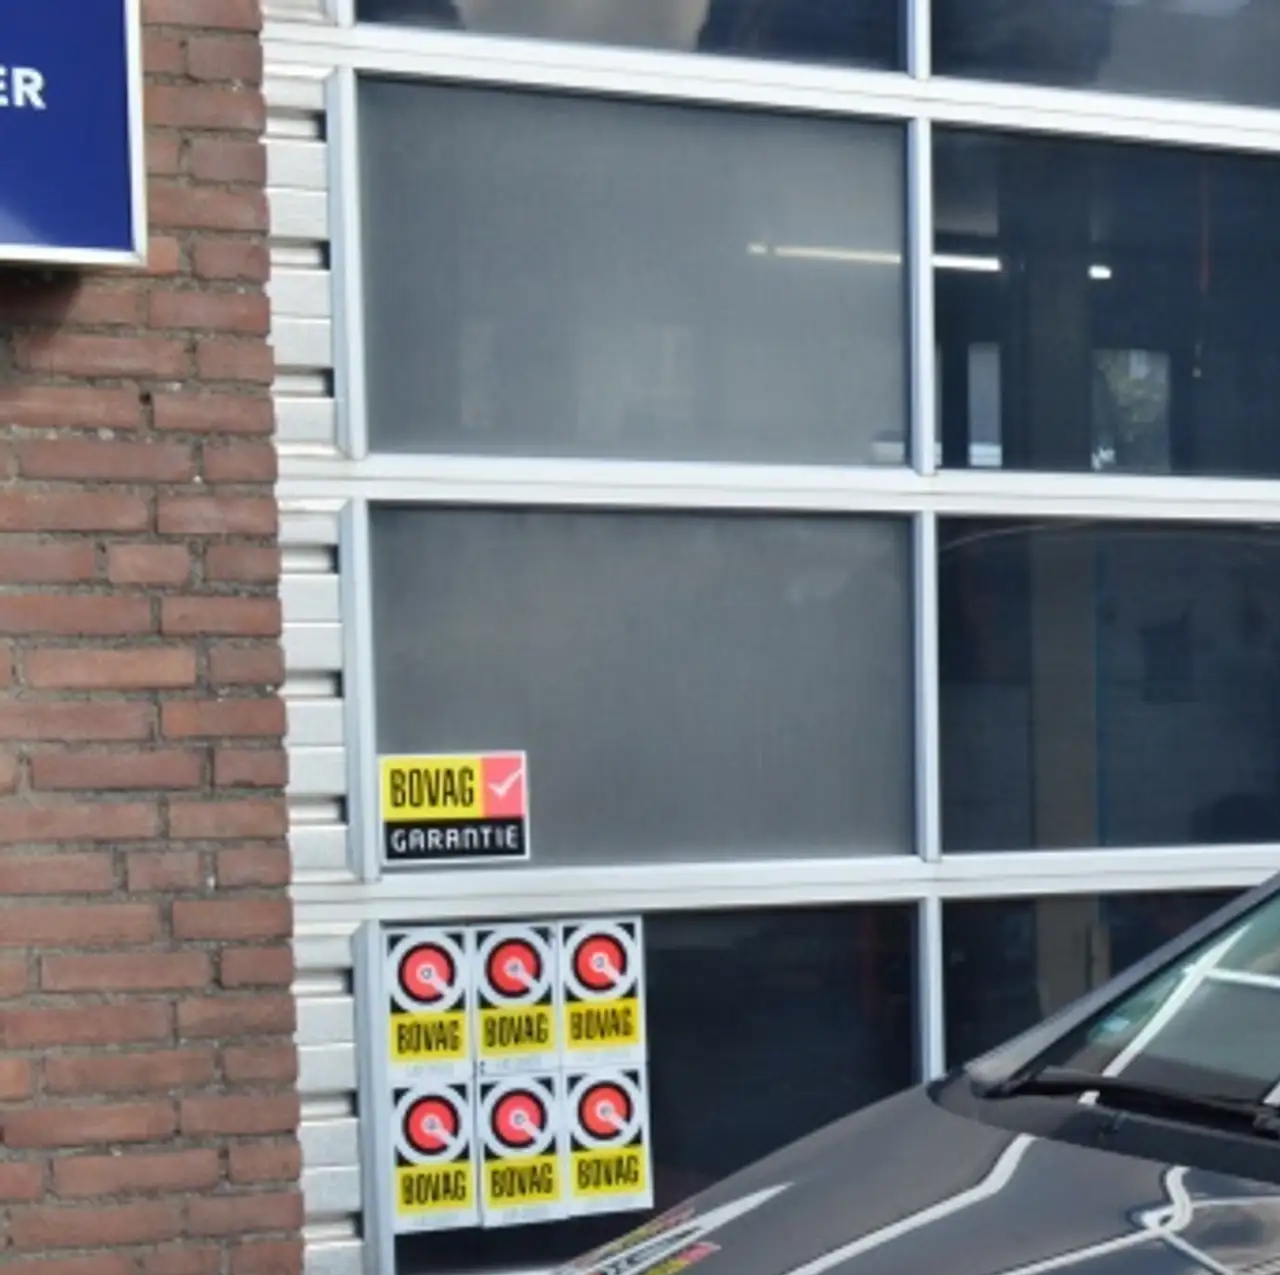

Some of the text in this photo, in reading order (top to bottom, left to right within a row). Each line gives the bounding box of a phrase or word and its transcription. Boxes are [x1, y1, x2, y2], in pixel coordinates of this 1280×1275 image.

[390, 767, 475, 808] BOVAG
[390, 824, 518, 853] GARANTIE
[397, 1020, 461, 1054] BOVAG
[484, 1012, 549, 1047] BOVAG
[570, 1006, 633, 1041] BOVAG
[403, 1169, 467, 1205] BOVAG
[490, 1161, 554, 1198] BOVAG
[577, 1155, 639, 1189] BOVAG
